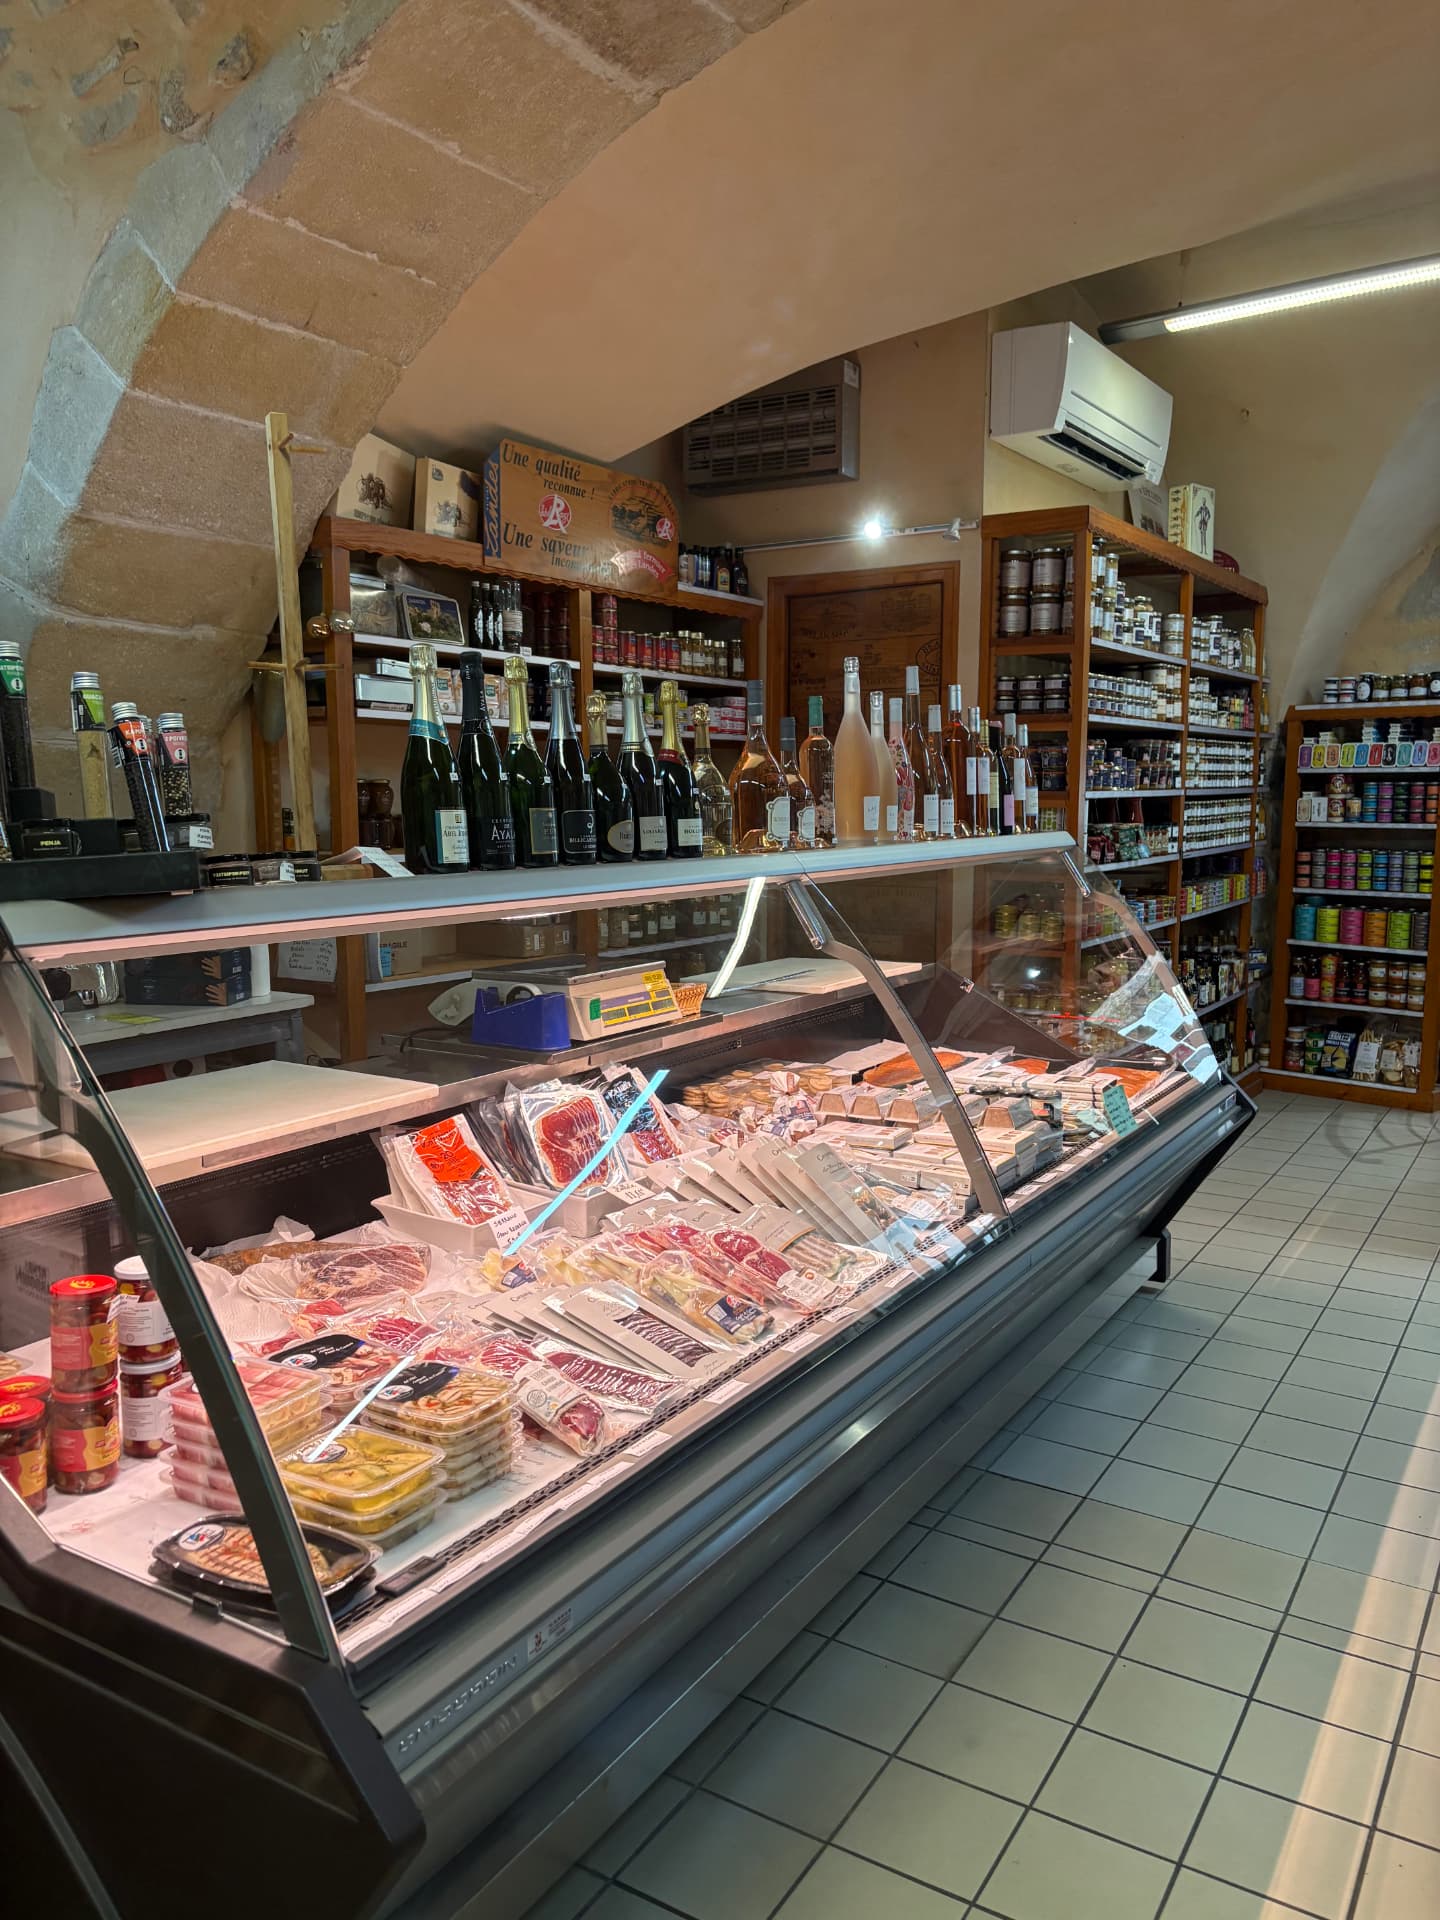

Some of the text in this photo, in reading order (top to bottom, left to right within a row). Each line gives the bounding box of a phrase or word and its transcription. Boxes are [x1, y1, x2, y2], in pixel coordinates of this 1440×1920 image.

[503, 443, 581, 481] Une qualité
[543, 479, 587, 499] reconnue
[503, 521, 534, 549] Une
